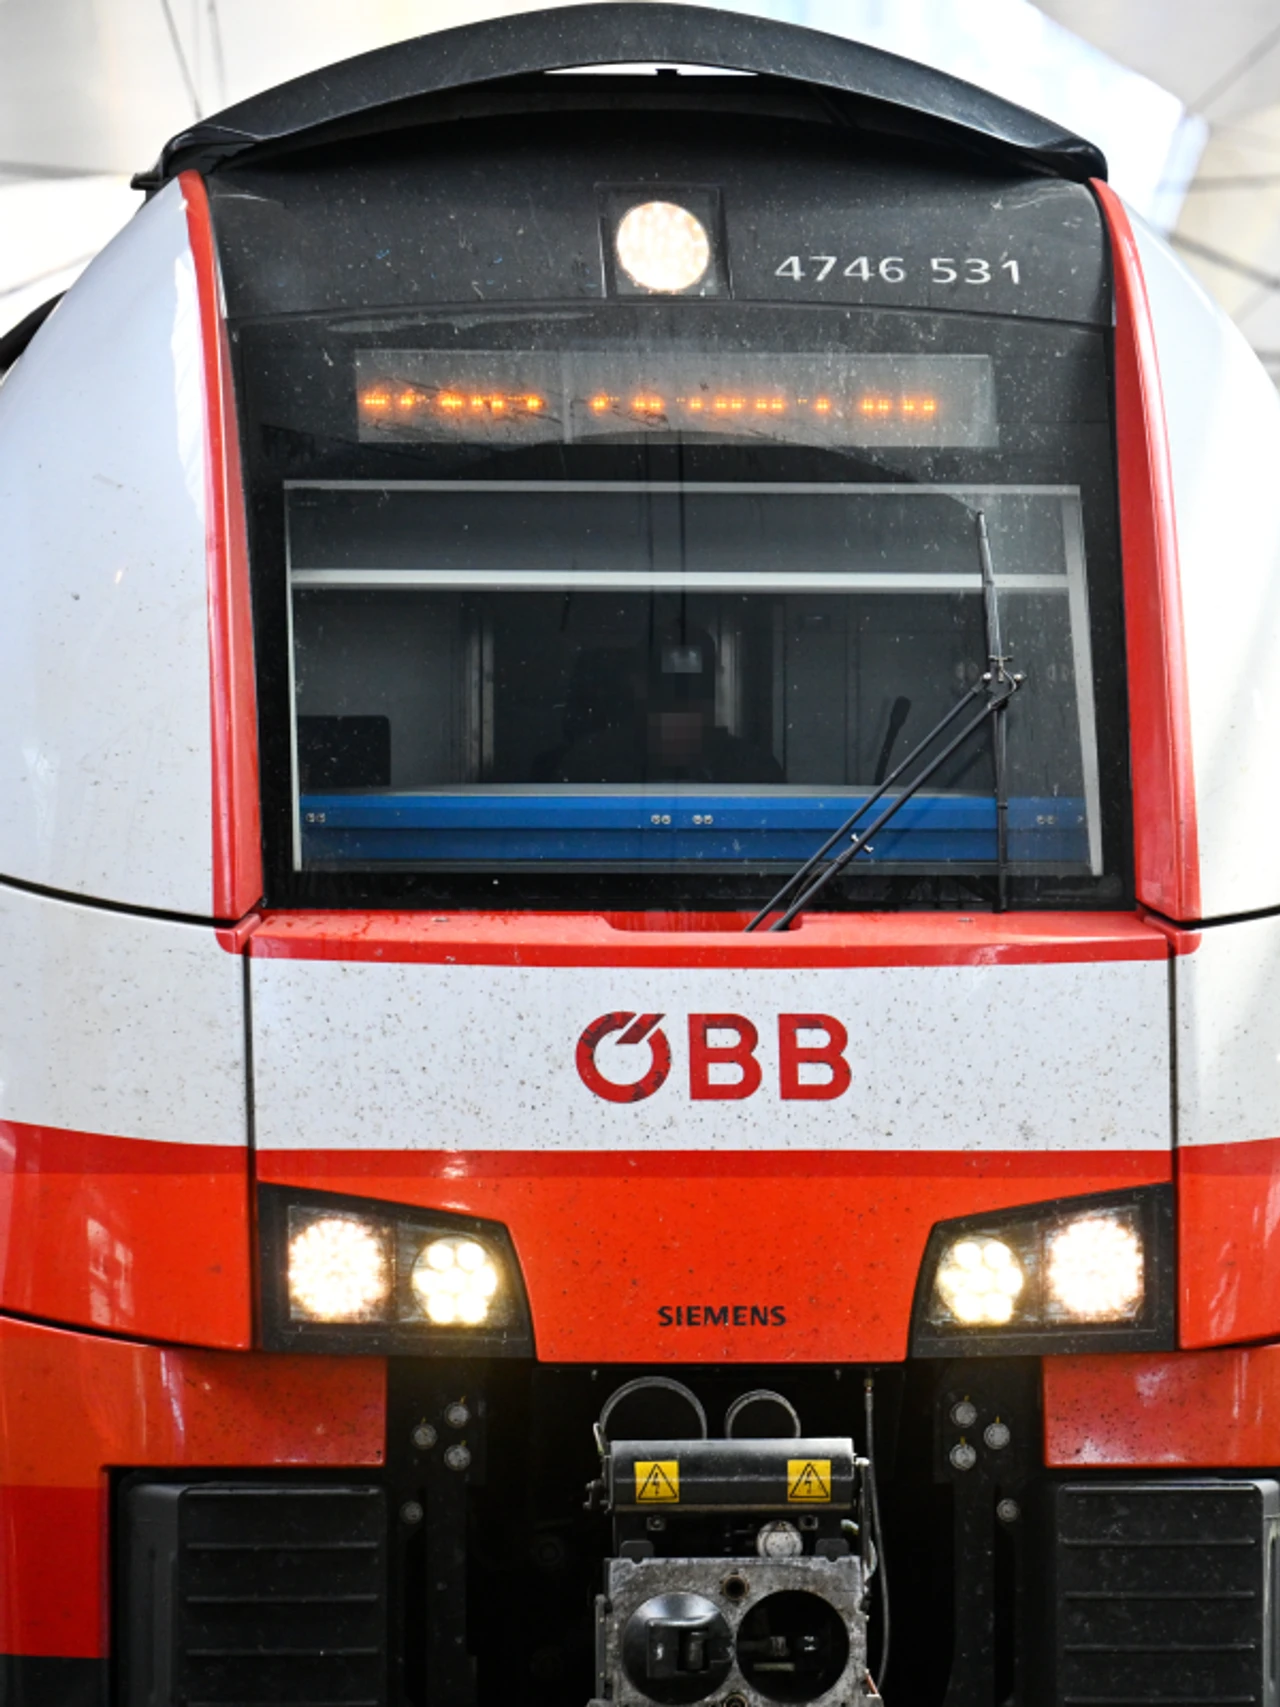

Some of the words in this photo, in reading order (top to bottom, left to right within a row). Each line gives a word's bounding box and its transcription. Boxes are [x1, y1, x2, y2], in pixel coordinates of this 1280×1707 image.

[774, 255, 906, 283] 4746
[929, 257, 1020, 285] 531
[575, 1011, 853, 1103] ÖBB
[657, 1304, 787, 1327] SIEMENS
